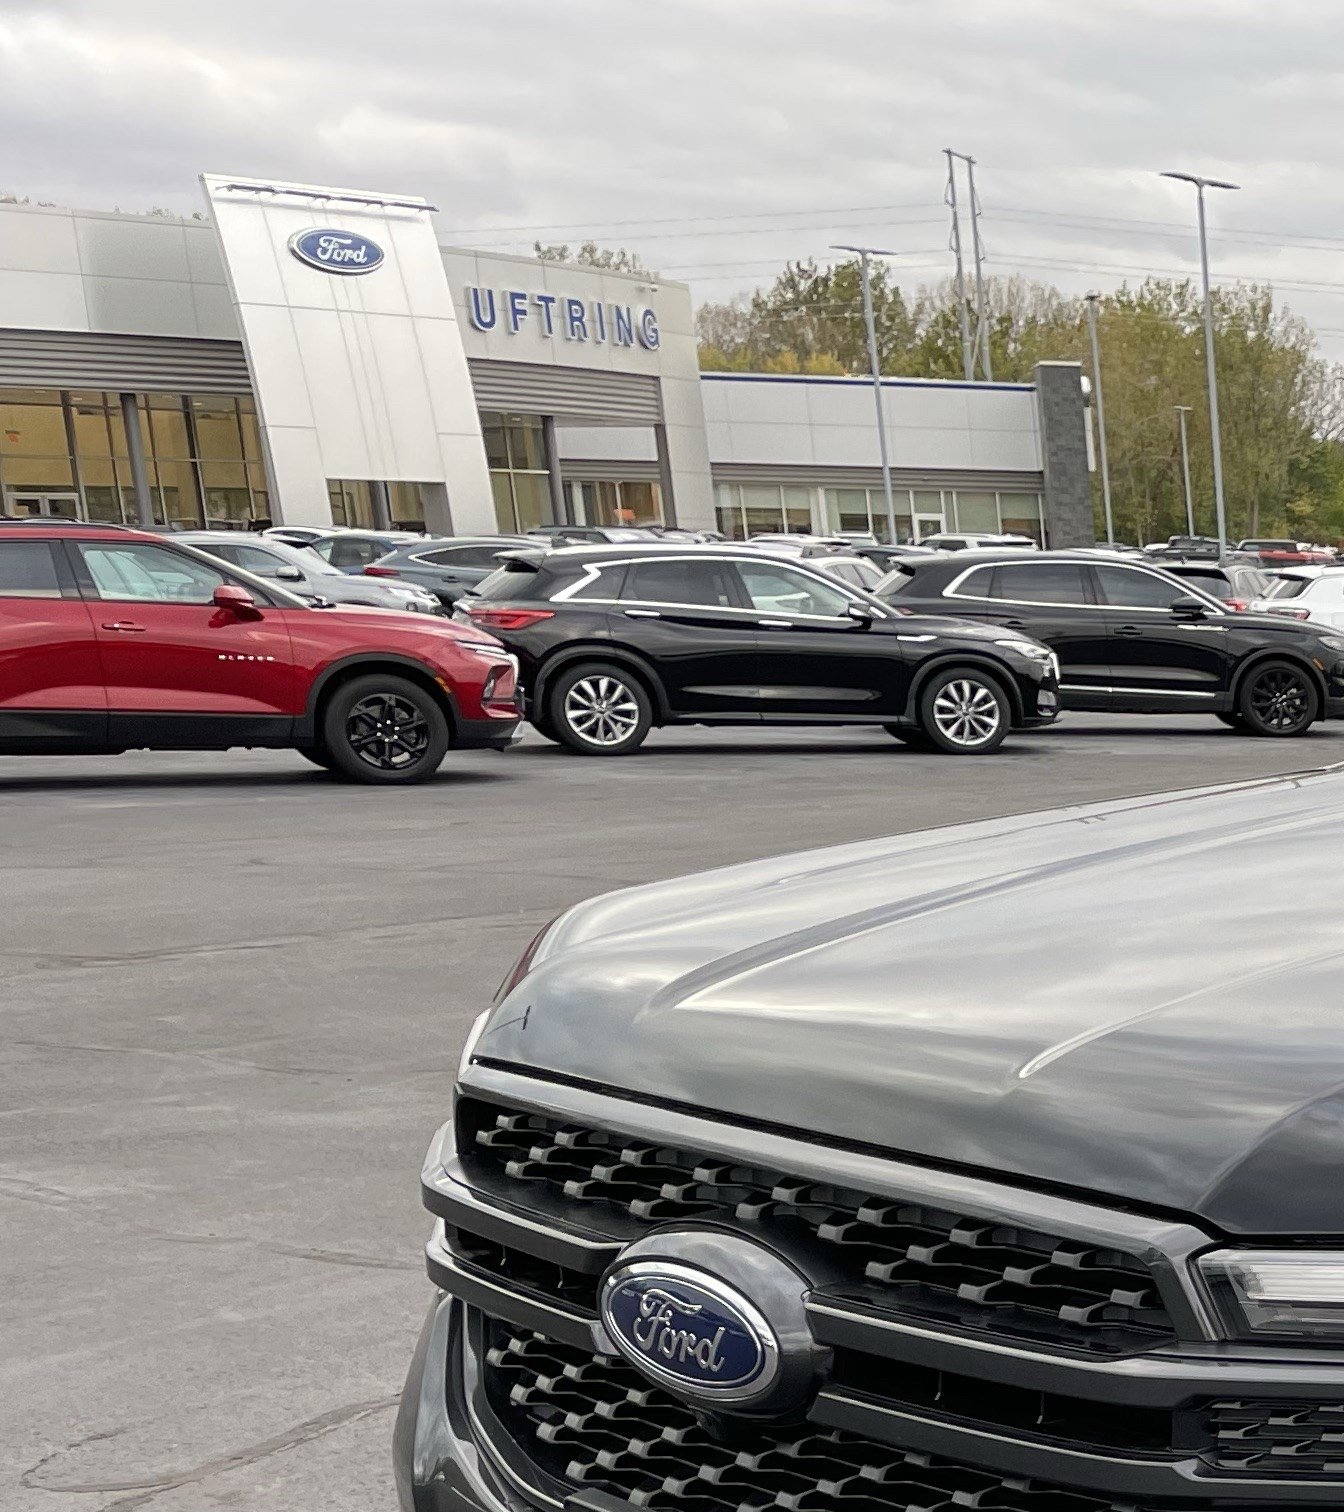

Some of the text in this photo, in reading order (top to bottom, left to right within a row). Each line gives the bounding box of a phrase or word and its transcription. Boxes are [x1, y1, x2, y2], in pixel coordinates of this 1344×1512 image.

[316, 236, 368, 264] Ford
[466, 286, 661, 351] UFTRING
[632, 1288, 726, 1373] Ford
